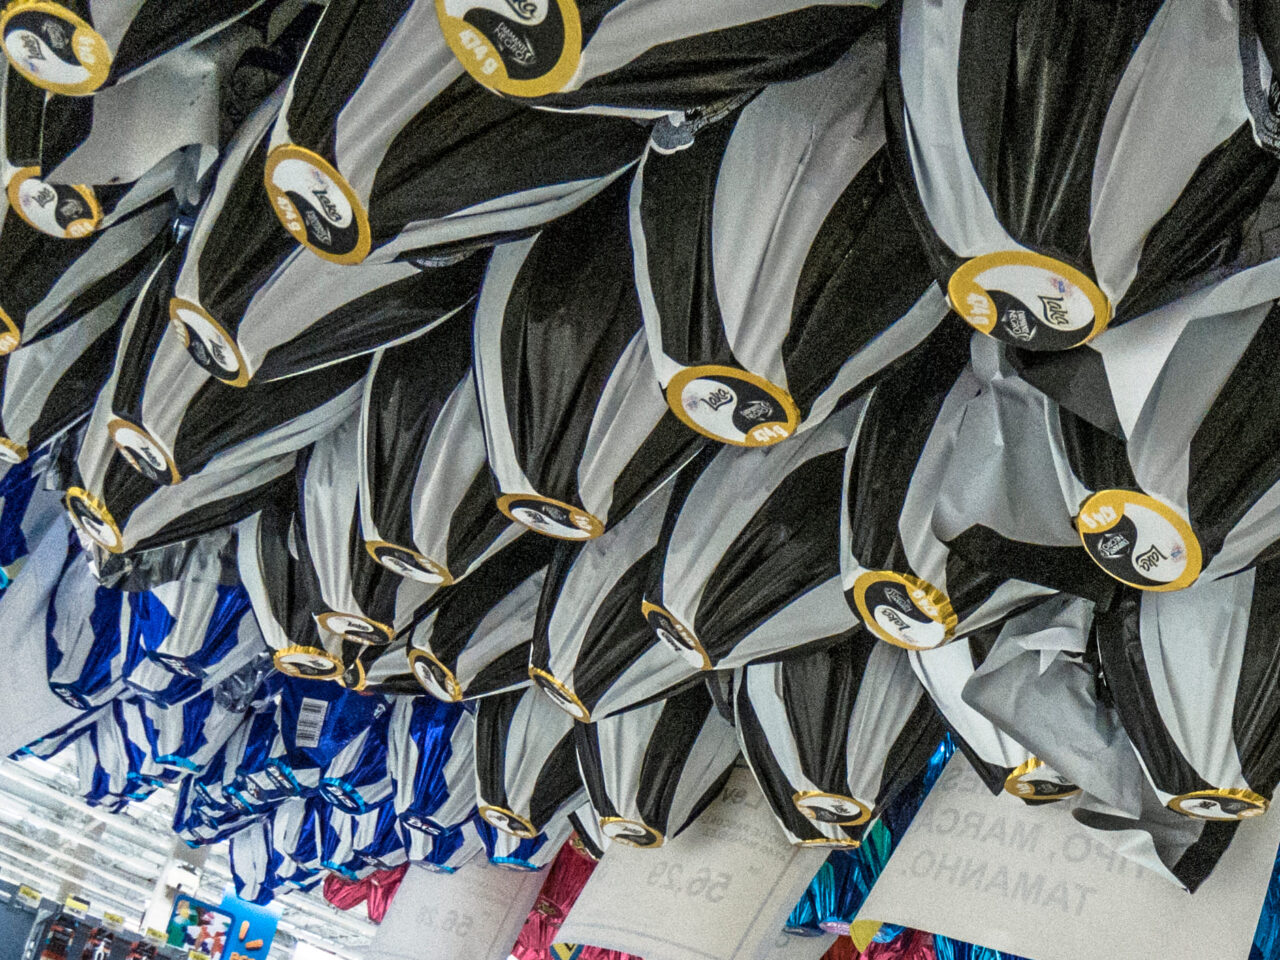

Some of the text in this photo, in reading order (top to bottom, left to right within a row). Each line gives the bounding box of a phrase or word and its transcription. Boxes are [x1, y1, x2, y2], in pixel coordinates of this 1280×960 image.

[312, 189, 342, 222] Laka
[1037, 295, 1069, 325] Laka
[700, 388, 734, 411] Laka
[1135, 544, 1168, 572] Laka
